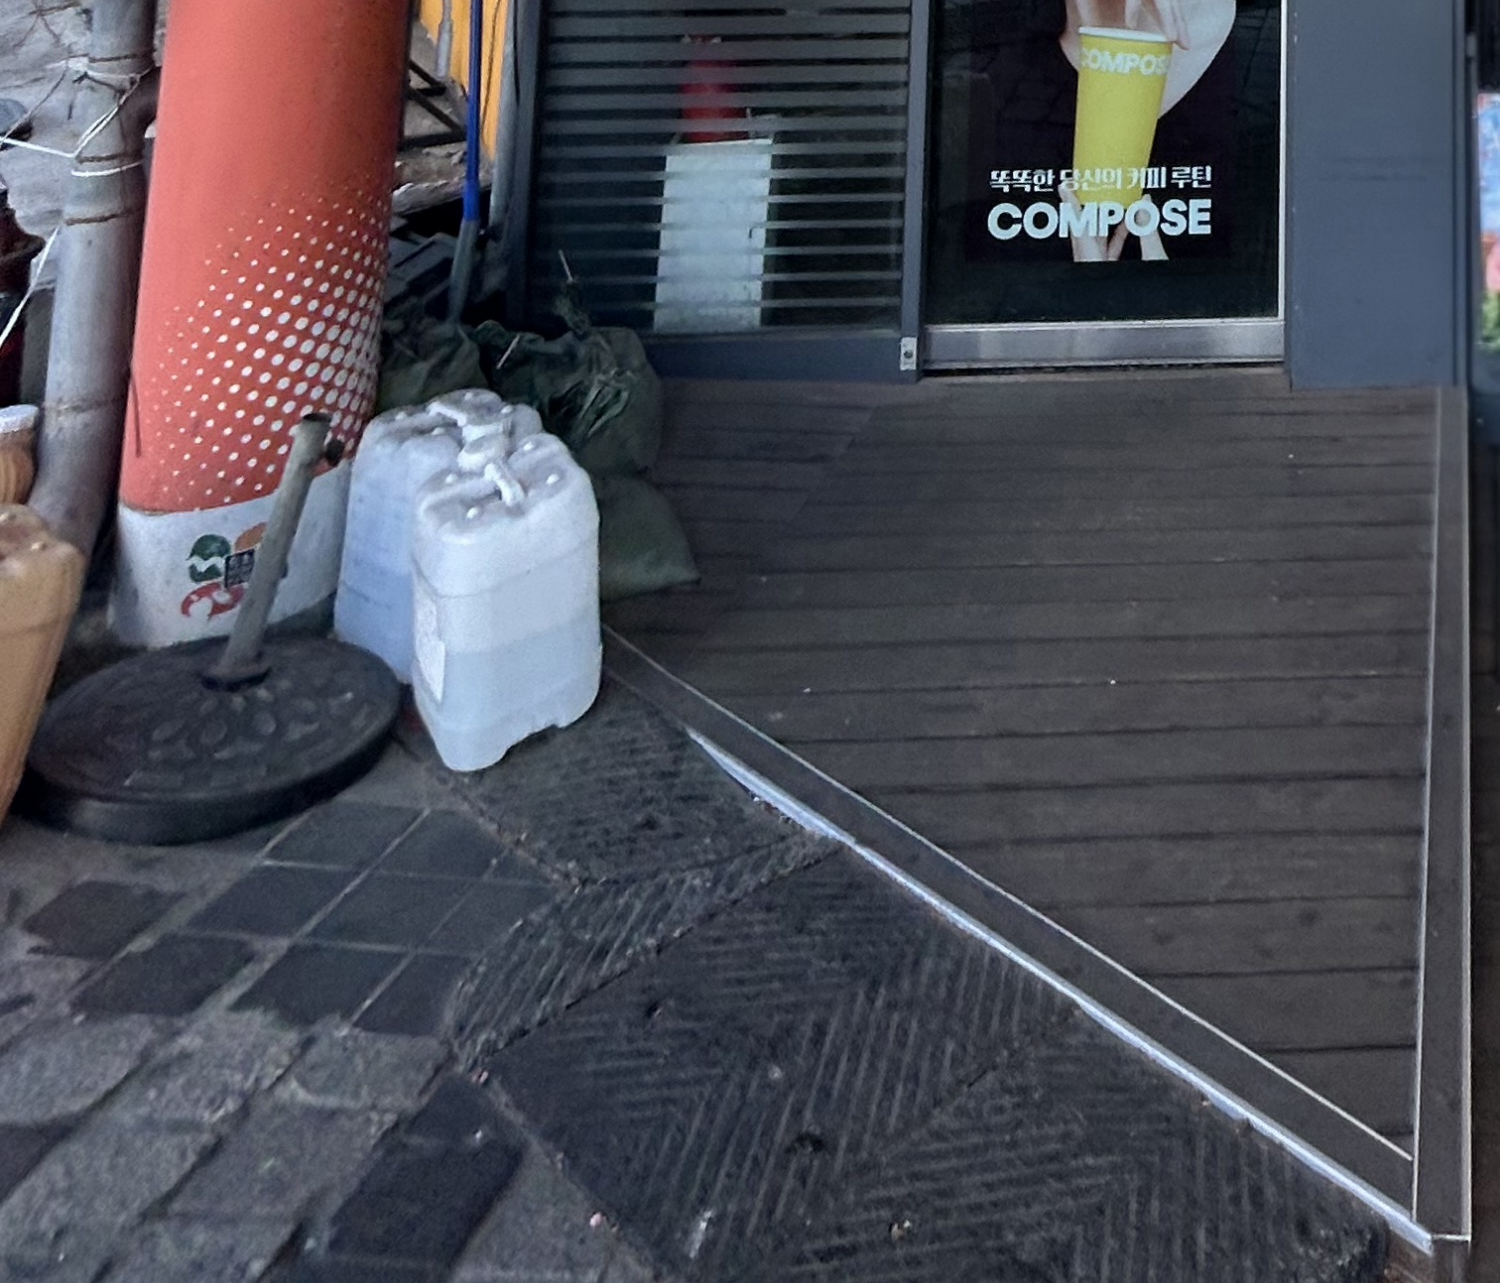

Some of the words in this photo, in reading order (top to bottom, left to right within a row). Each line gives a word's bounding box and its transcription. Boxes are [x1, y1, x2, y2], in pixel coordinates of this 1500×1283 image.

[989, 168, 1056, 193] 똑똑한
[1059, 166, 1122, 192] 당신의
[1126, 166, 1167, 190] 커피
[1171, 165, 1213, 189] 루틴
[986, 198, 1213, 241] COMPOSE
